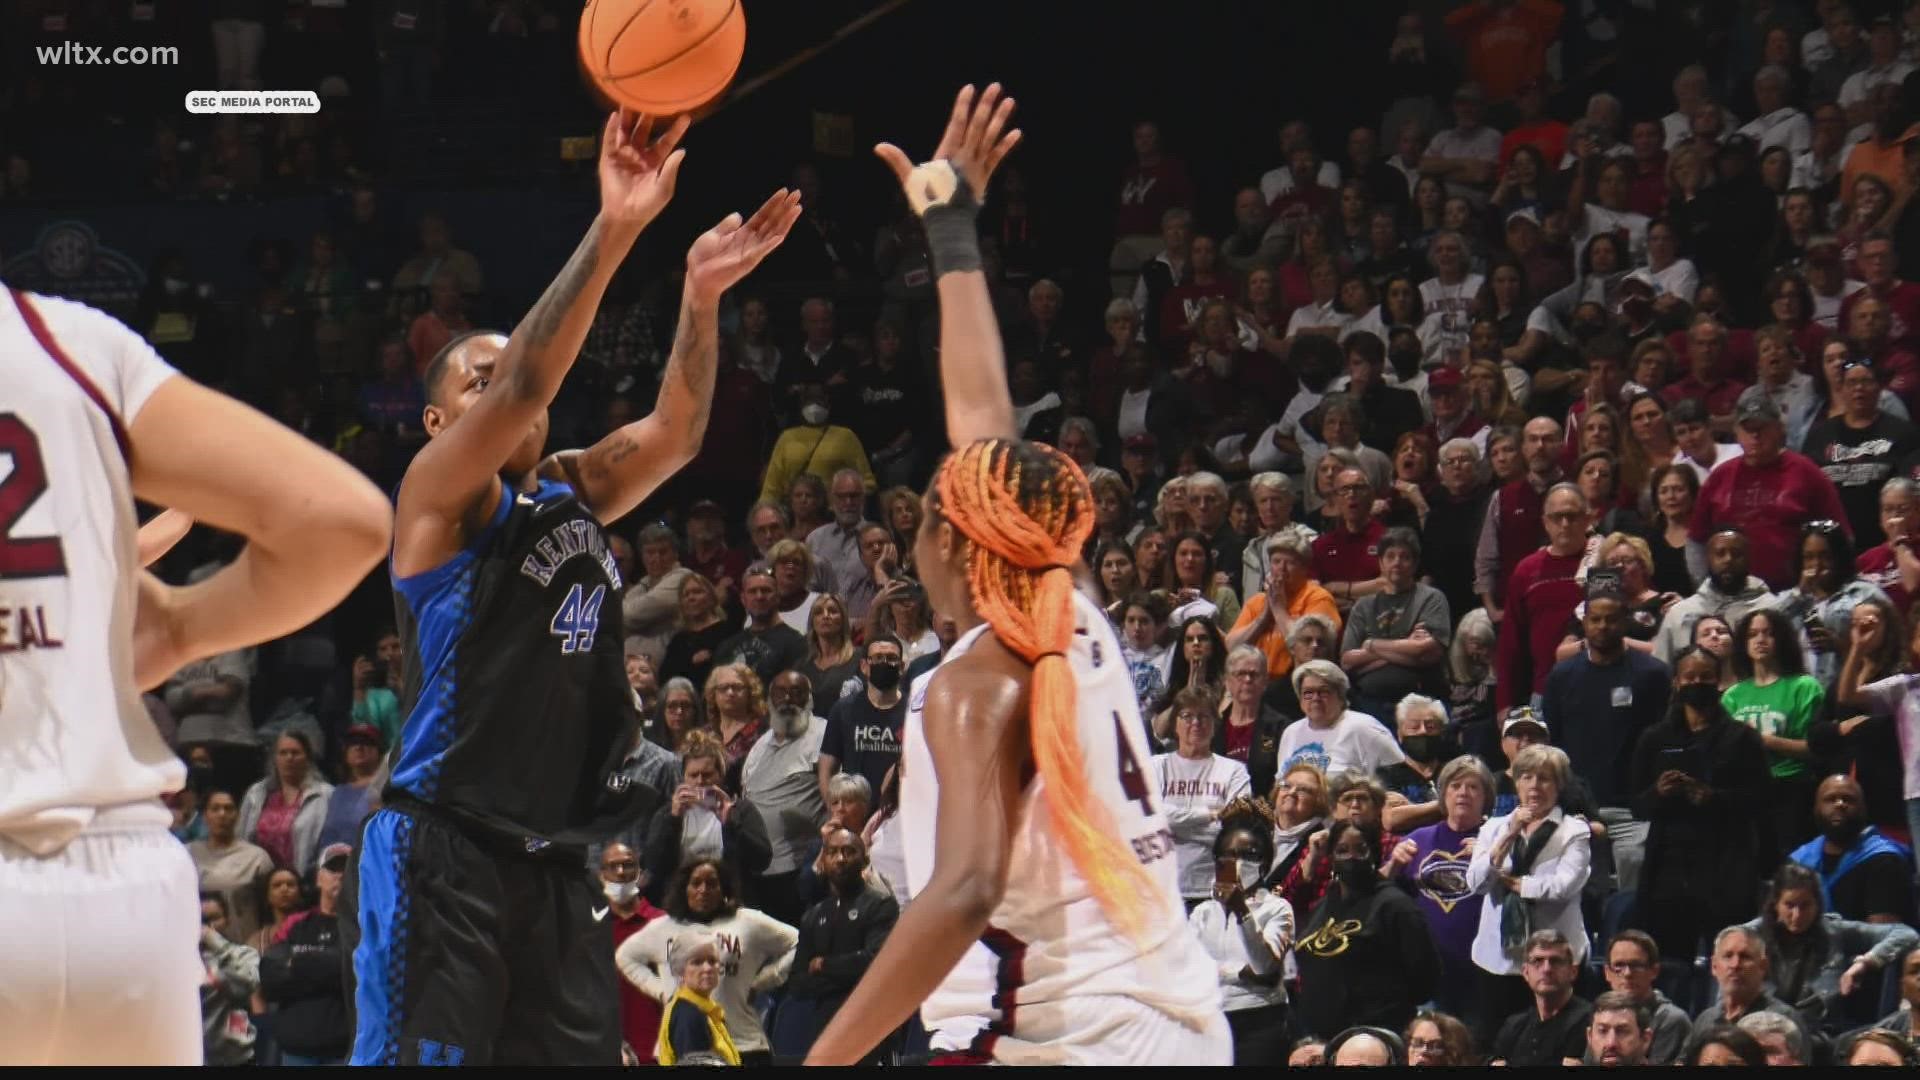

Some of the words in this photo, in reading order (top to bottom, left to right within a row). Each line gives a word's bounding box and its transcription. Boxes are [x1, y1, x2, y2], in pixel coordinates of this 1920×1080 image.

[550, 583, 606, 656] 44
[855, 725, 894, 741] HCA
[1112, 709, 1156, 817] 4
